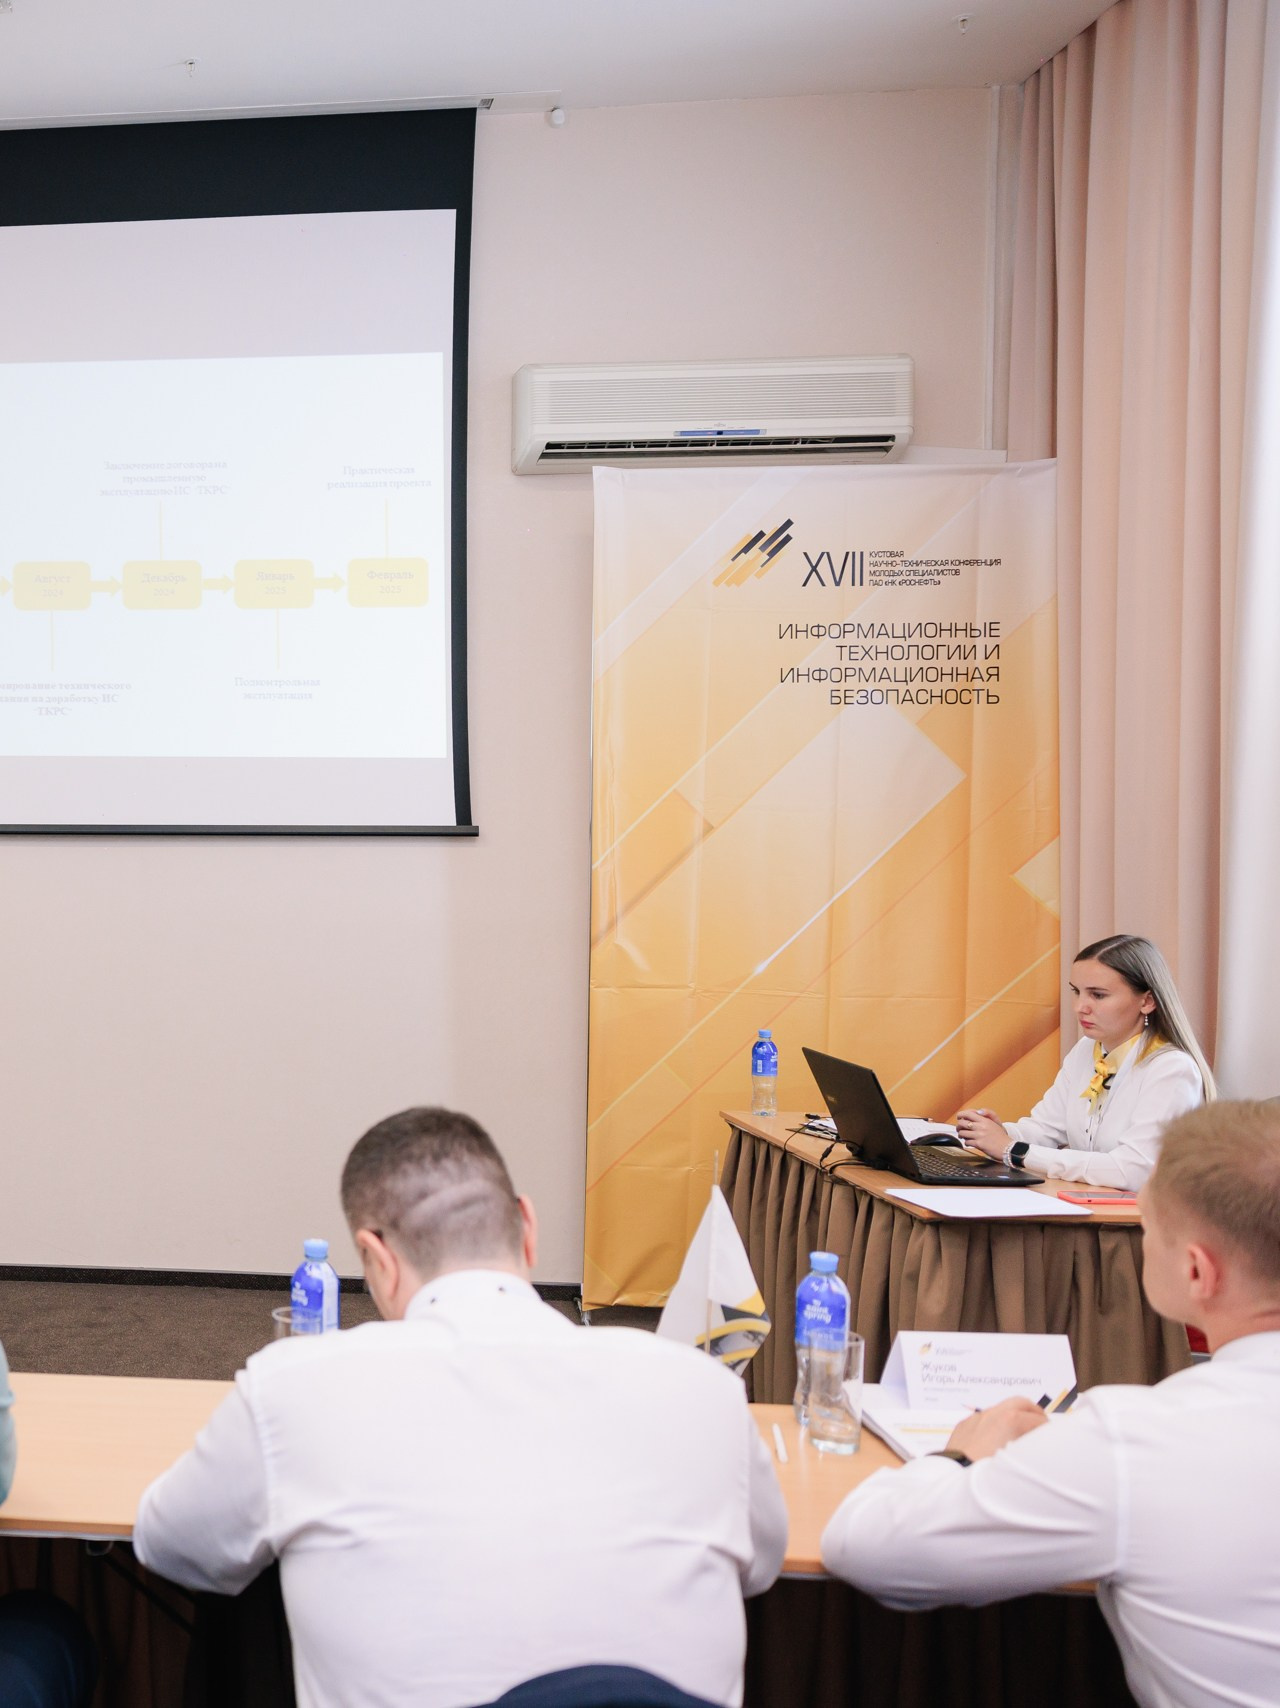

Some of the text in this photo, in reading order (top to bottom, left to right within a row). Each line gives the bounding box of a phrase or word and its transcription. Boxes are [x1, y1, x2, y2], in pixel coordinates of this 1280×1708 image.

[104, 460, 164, 470] Заключение
[166, 461, 212, 471] договора
[343, 465, 415, 477] Практическая
[122, 475, 206, 485] промышленную
[327, 480, 431, 490] реализация проекта
[869, 558, 1001, 567] НАУЧНО-ТЕХНИЧЕСКАЯ КОНФЕРЕНЦИЯ
[802, 551, 864, 587] XVII
[869, 568, 961, 577] МОЛОДЫХ СПЕЦИАЛИСТОВ
[34, 574, 72, 585] Август
[140, 572, 188, 584] Декабрь
[256, 571, 296, 582] Январь
[366, 570, 414, 581] Февраль
[898, 578, 941, 586] «РОСНЕФТЬ»
[42, 588, 64, 598] 2024
[153, 587, 175, 597] 2024
[264, 586, 287, 595] 2025
[379, 585, 402, 594] 2025
[778, 621, 1001, 641] ИНФОРМАЦИОННЫЕ
[836, 644, 1001, 661] ТЕХНОЛОГИИ И
[780, 666, 1000, 685] ИНФОРМАЦИОННАЯ
[58, 681, 132, 691] технического
[234, 676, 321, 688] Подконтрольная
[31, 695, 44, 703] на
[45, 693, 98, 705] доработку
[101, 693, 119, 703] ИС
[242, 691, 313, 701] эксплуатация
[830, 688, 1000, 705] БЕЗОПАСНОСТЬ
[803, 1309, 832, 1324] spring
[921, 1361, 957, 1374] Жуков
[921, 1373, 1042, 1387] Игорь Александрович
